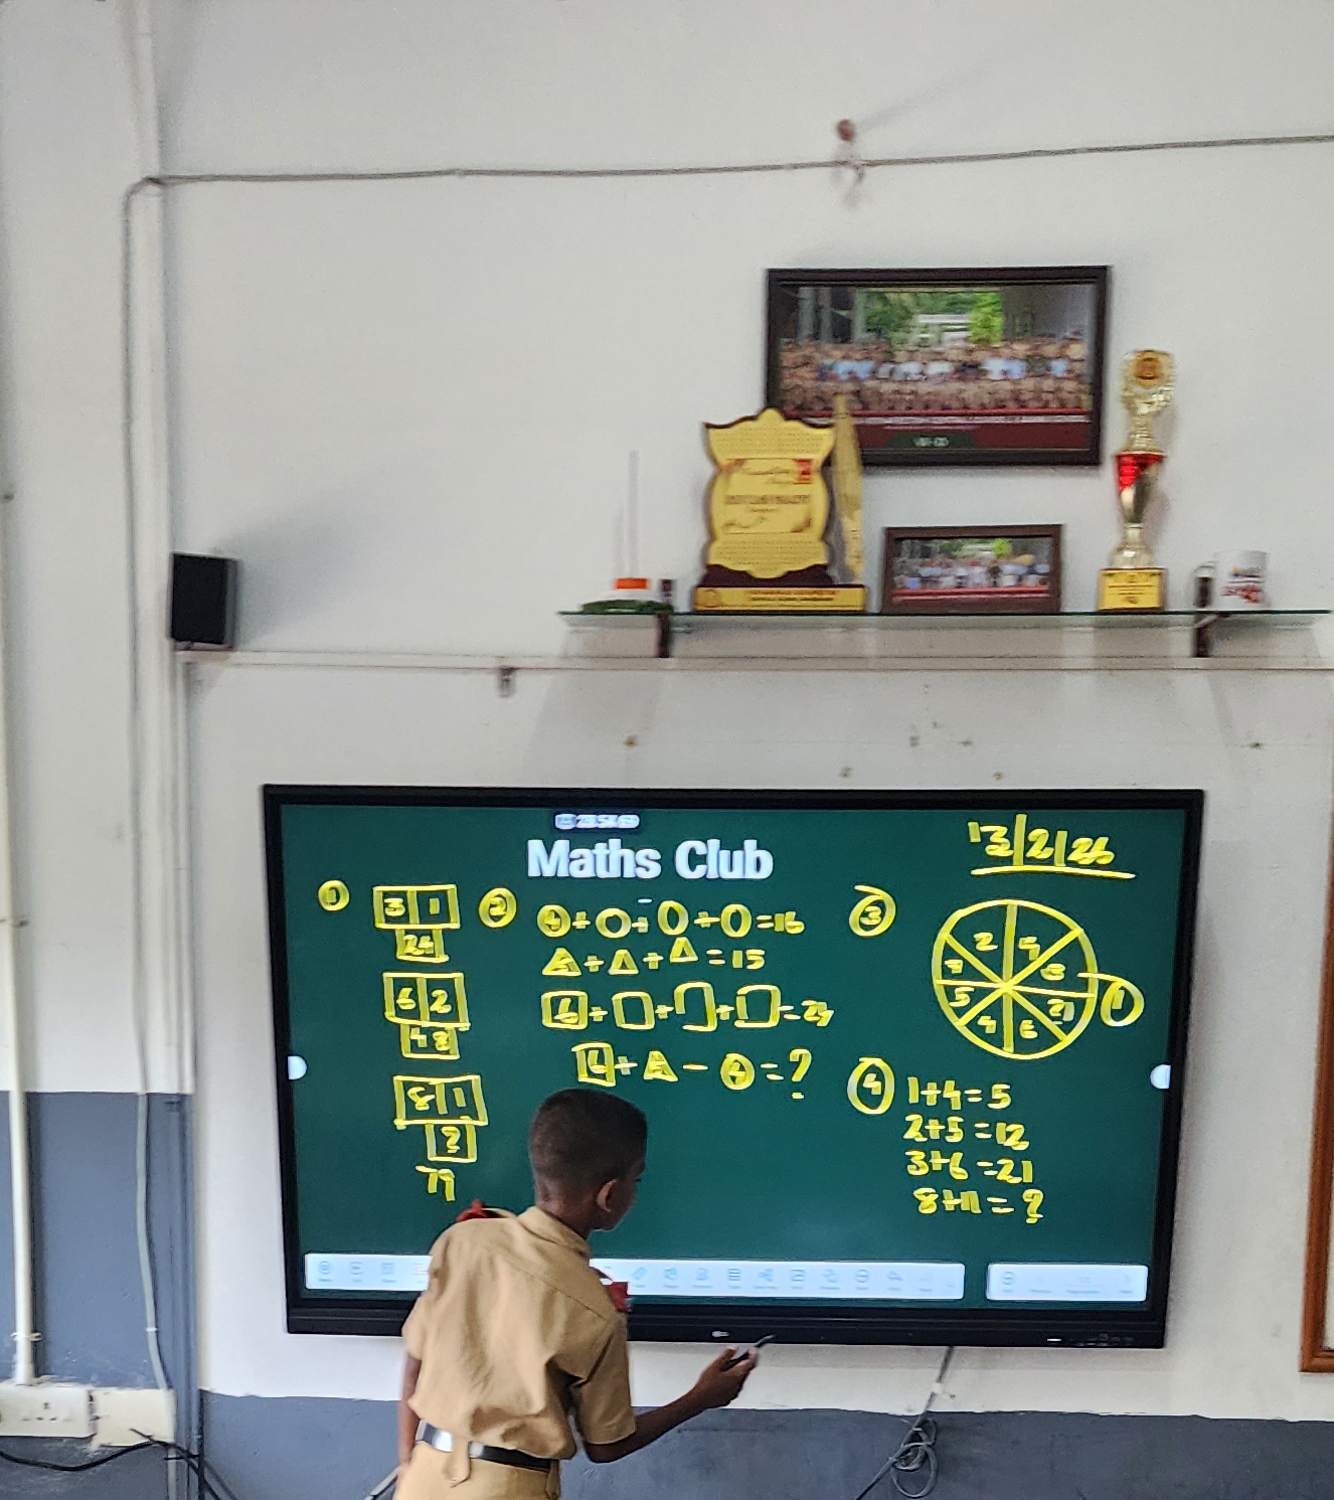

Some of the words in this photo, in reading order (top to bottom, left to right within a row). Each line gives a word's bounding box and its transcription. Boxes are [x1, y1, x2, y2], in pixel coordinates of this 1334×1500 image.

[527, 838, 662, 879] Maths
[674, 838, 774, 879] Club
[384, 897, 407, 917] 3
[973, 931, 999, 952] 2
